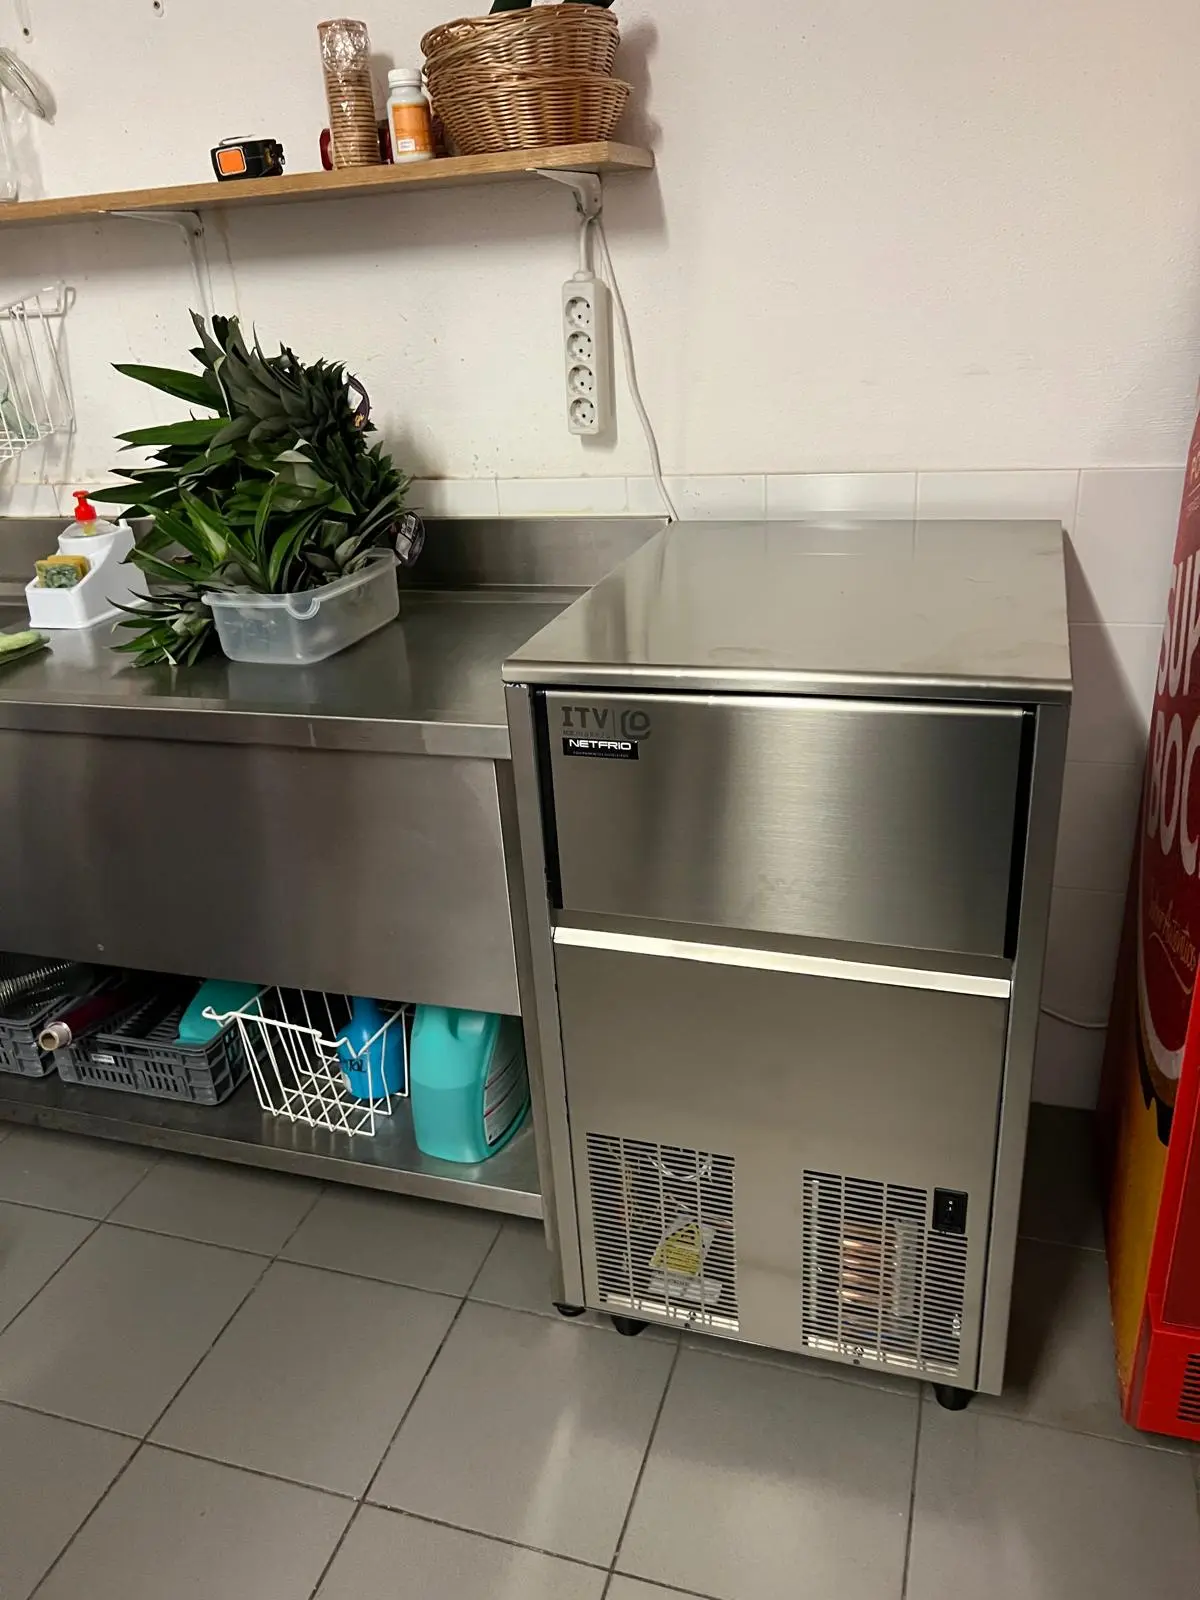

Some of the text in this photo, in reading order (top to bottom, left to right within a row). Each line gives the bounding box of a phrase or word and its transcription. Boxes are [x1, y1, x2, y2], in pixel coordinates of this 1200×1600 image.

[561, 706, 608, 729] ITV
[569, 739, 632, 751] NETFRIO
[1147, 710, 1200, 877] BOC
